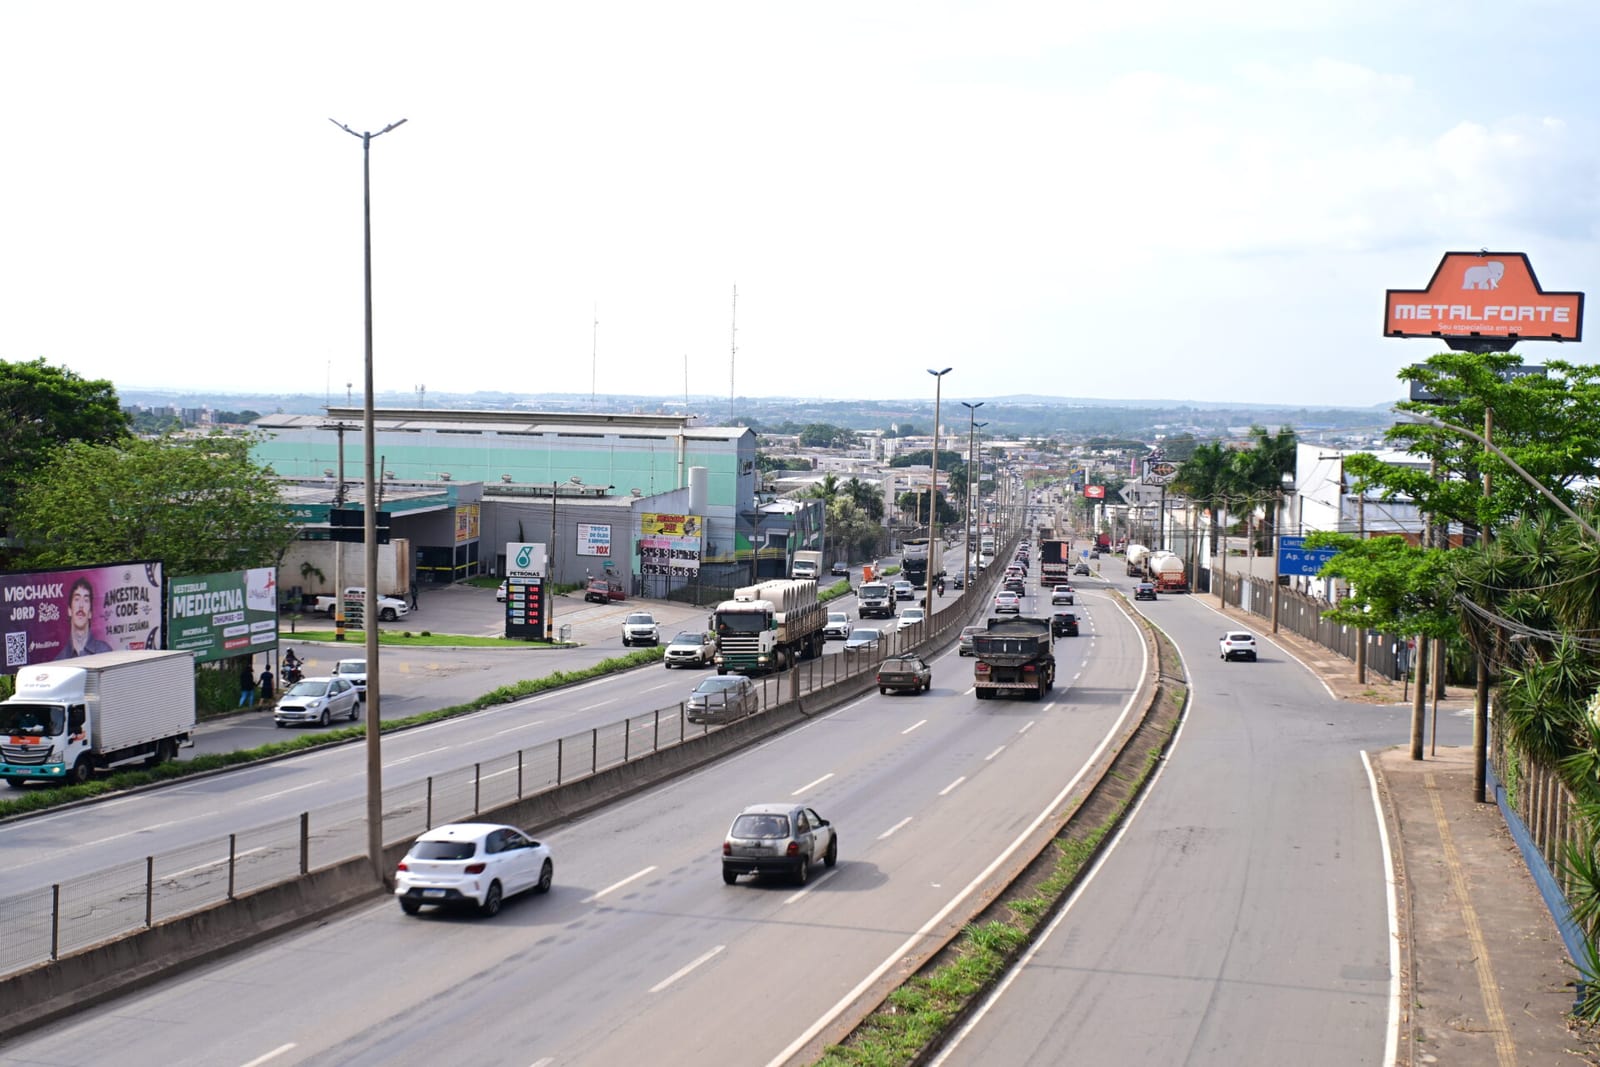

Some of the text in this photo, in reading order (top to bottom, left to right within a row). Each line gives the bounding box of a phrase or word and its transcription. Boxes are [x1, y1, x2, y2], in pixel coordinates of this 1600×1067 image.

[1394, 304, 1570, 323] METALFORTE
[1438, 323, 1452, 331] Seu
[1453, 323, 1494, 332] especialista
[596, 545, 609, 554] 10X
[1304, 553, 1315, 561] de
[4, 583, 64, 603] MOCHAKK
[173, 582, 207, 594] VESTIBULAR
[103, 586, 150, 609] ANCESTRAL
[172, 588, 244, 619] MEDICINA
[115, 602, 139, 617] CODE
